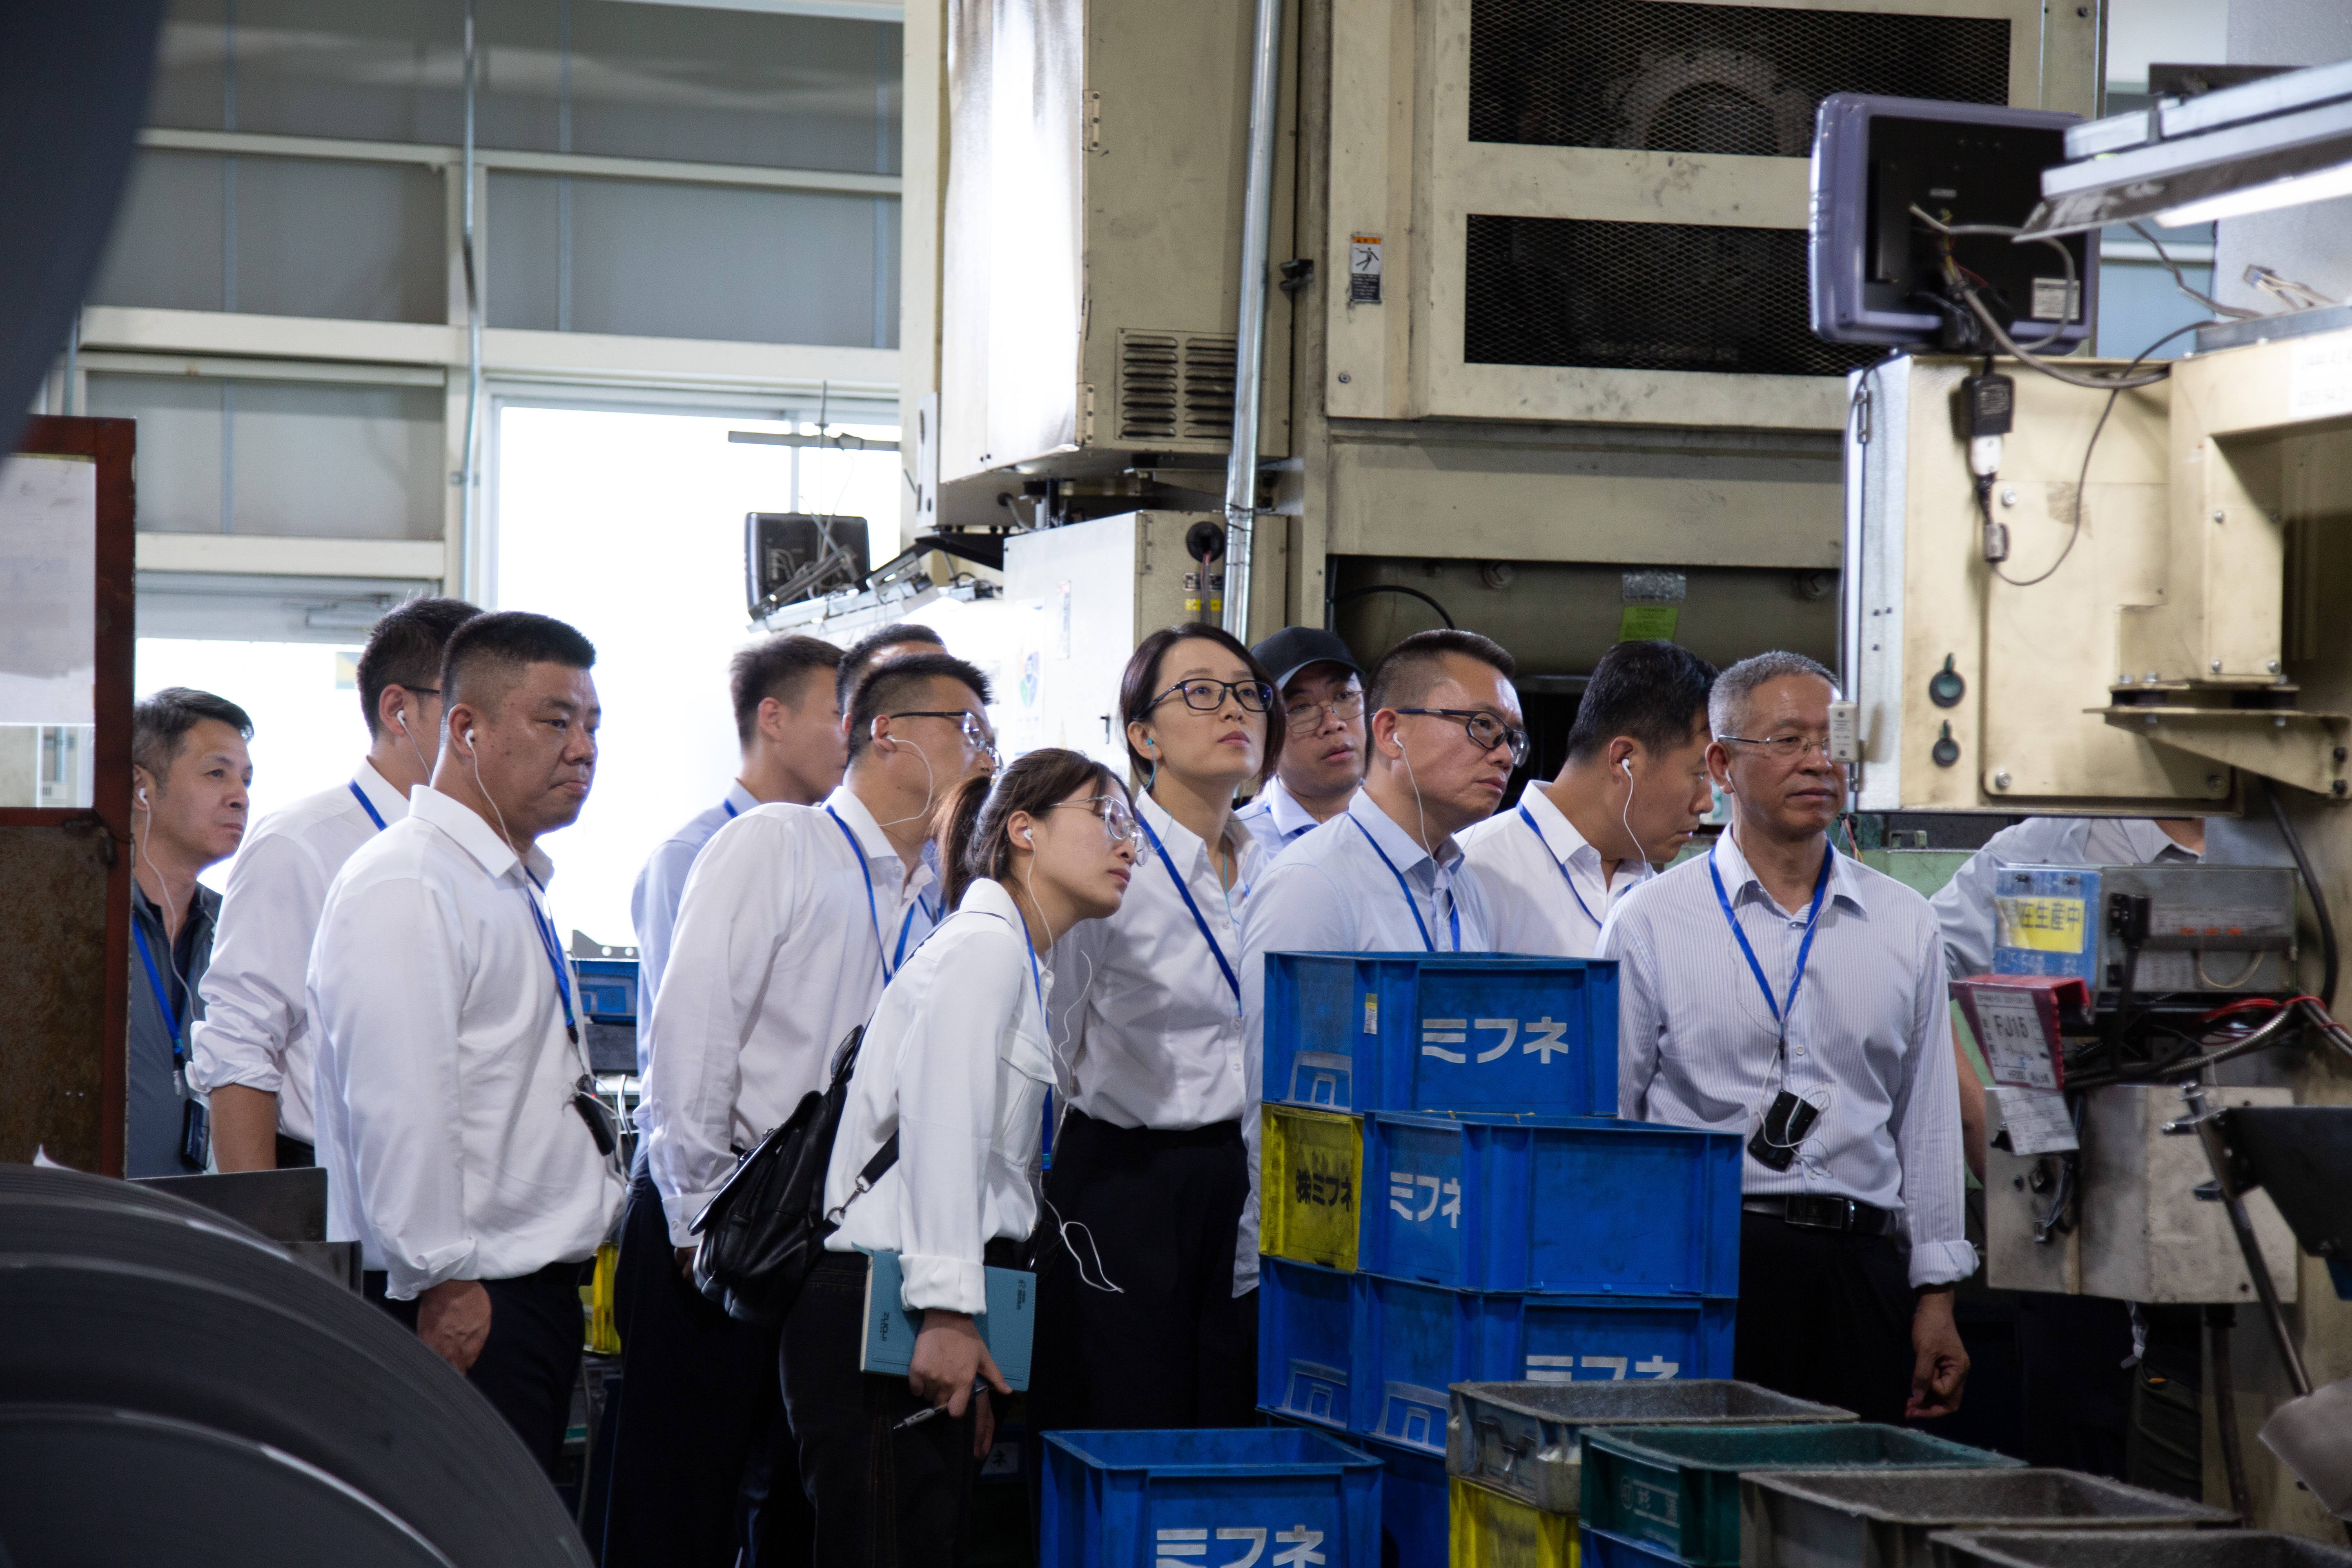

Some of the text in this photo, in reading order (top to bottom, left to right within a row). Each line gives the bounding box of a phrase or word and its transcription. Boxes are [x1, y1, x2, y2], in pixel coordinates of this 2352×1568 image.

[1422, 1016, 1568, 1064] ミフネ
[1156, 1524, 1325, 1568] ミフネ
